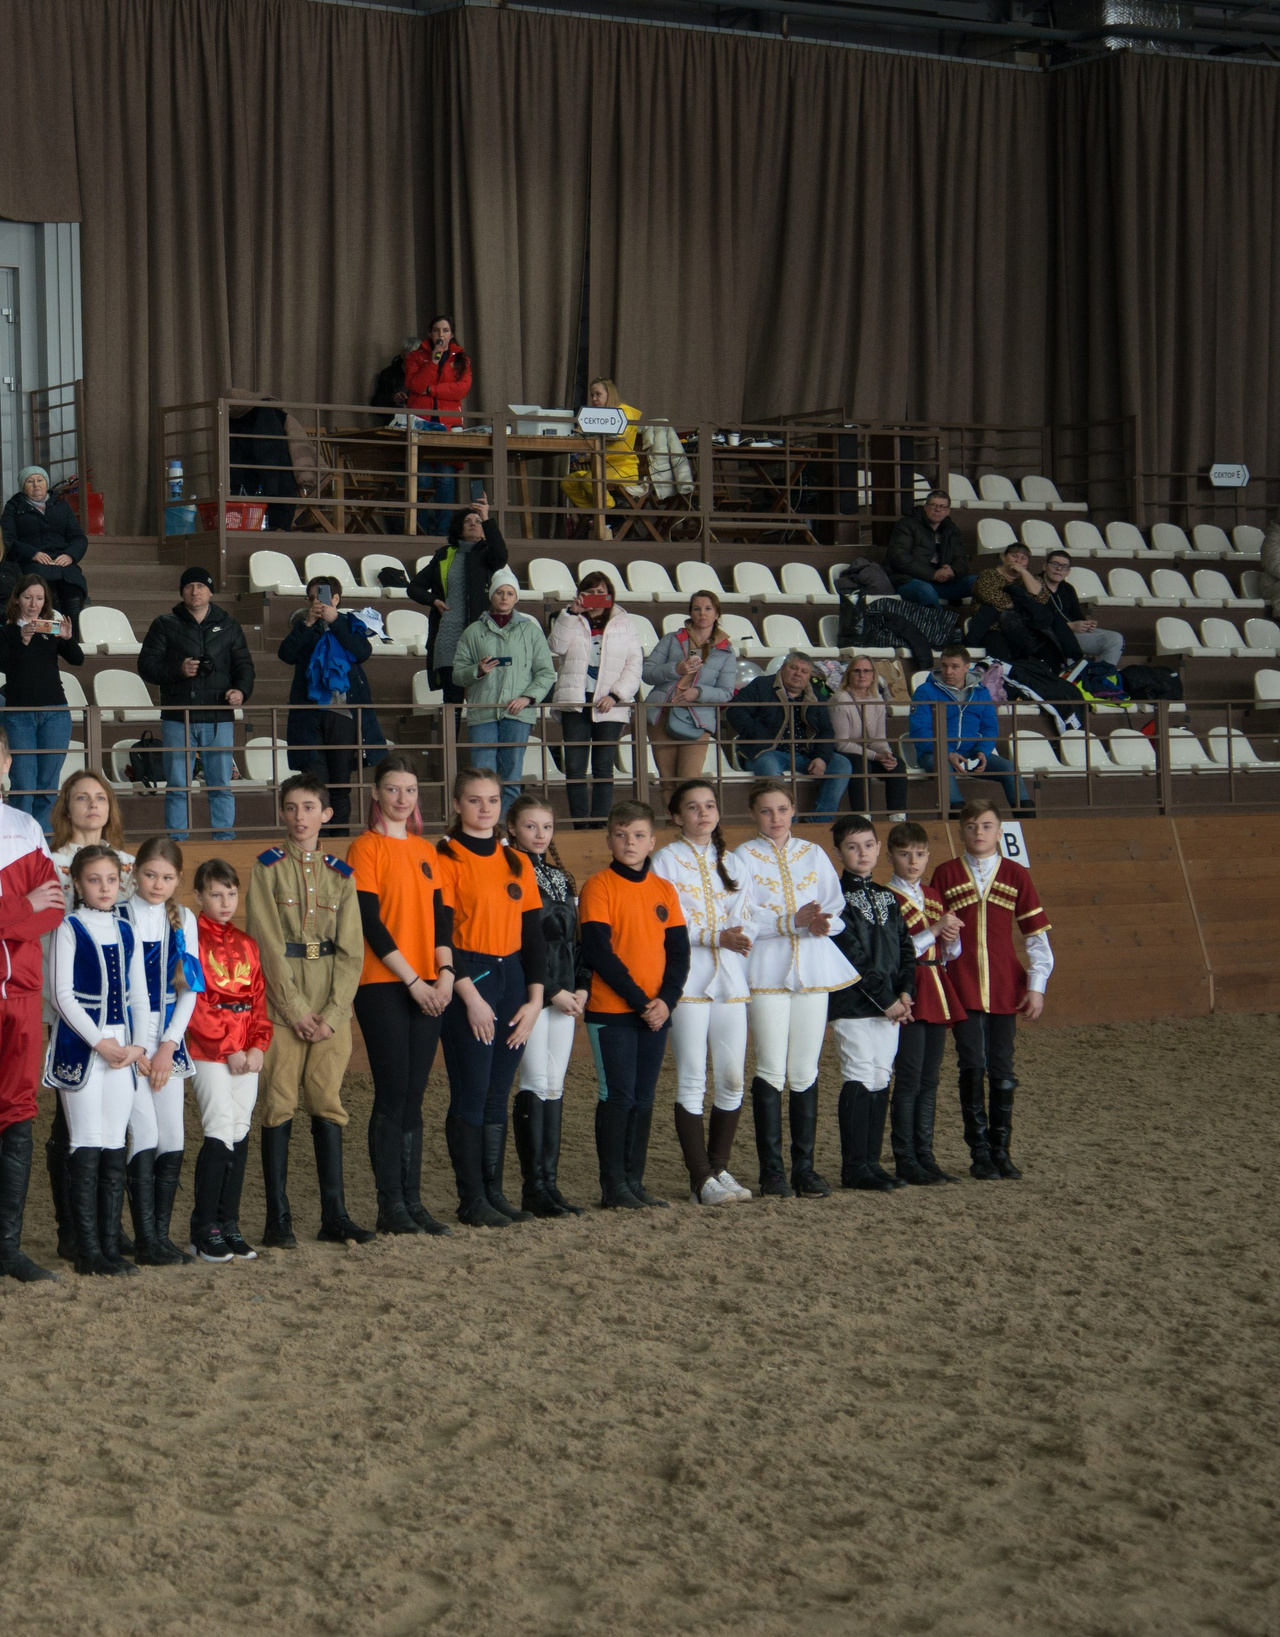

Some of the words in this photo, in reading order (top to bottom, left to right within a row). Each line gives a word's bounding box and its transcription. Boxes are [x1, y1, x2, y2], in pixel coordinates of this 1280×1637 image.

[583, 417, 609, 425] СЕКТОР
[610, 416, 616, 426] D
[1213, 471, 1236, 479] СЕКТОР
[1003, 832, 1020, 857] B
